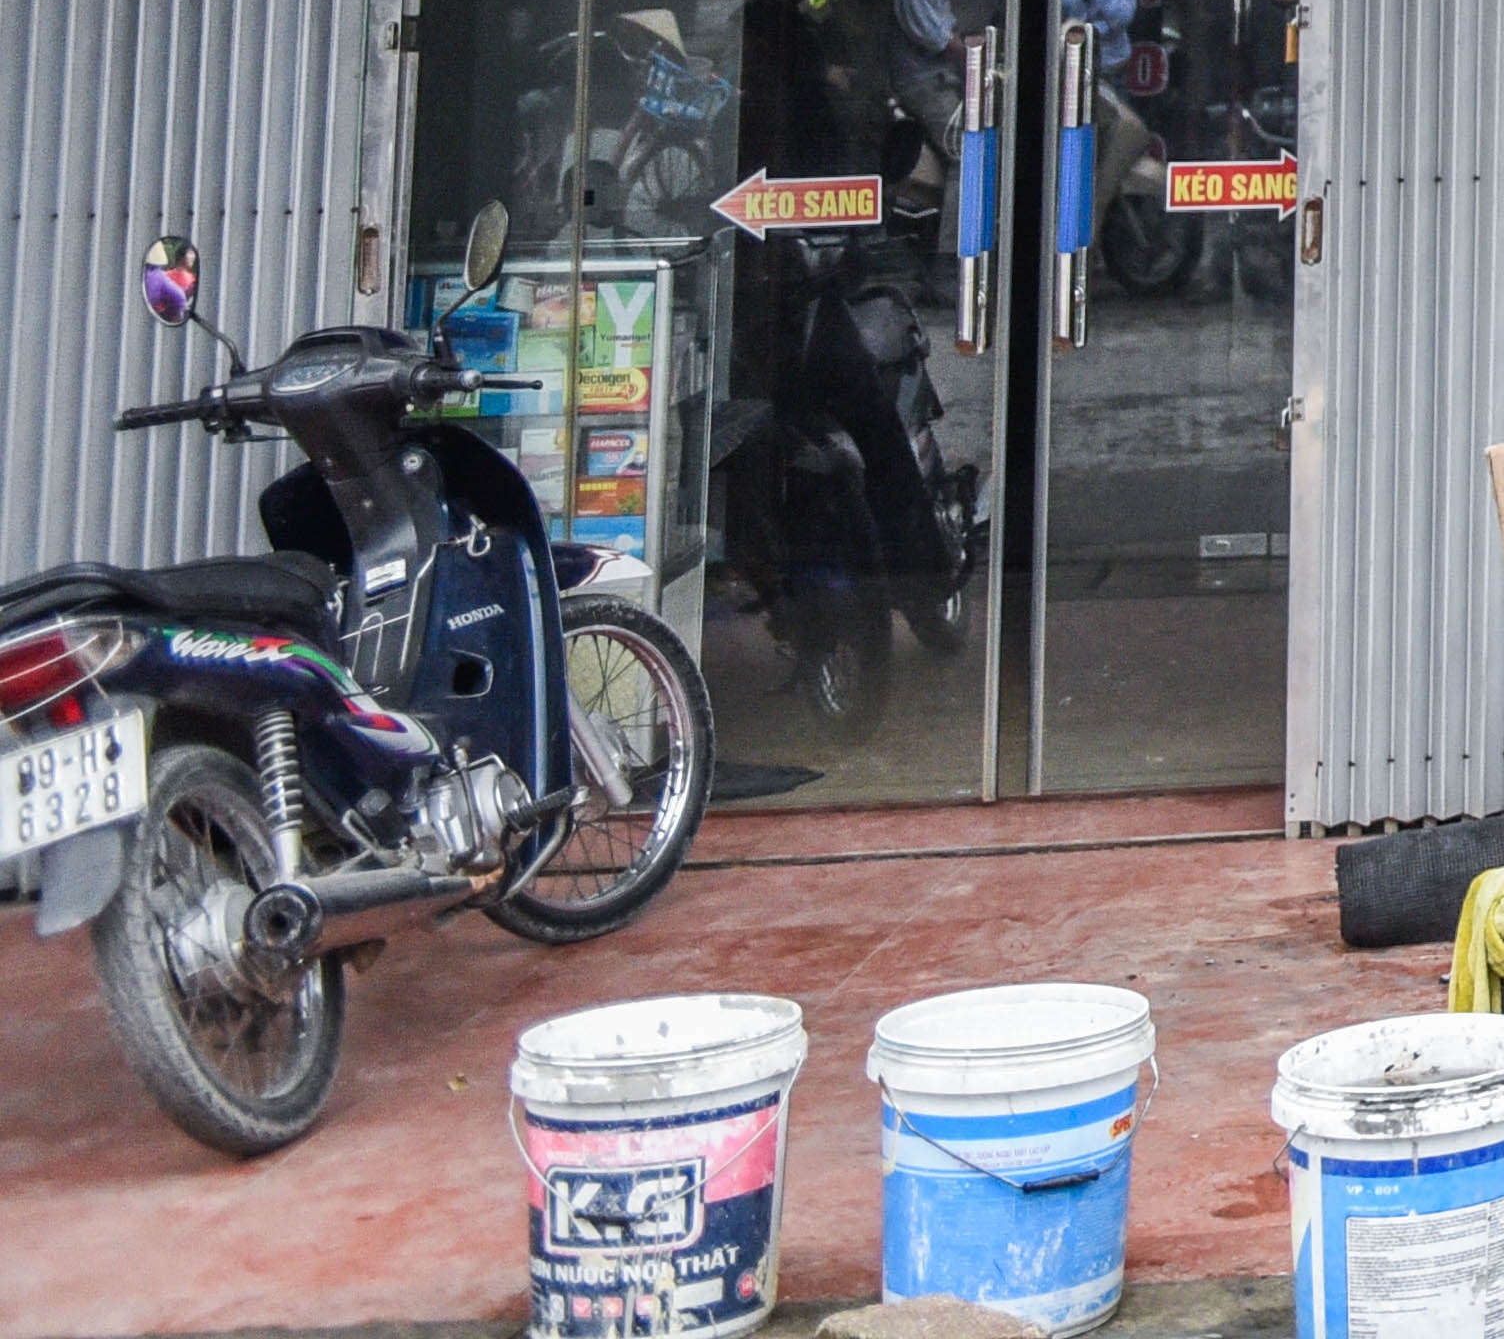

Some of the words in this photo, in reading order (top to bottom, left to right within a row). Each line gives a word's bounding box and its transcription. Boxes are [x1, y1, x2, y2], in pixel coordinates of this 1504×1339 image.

[744, 180, 796, 220] KÉO
[803, 187, 875, 219] SANG
[1173, 169, 1223, 203] KÉO
[1230, 173, 1298, 201] SANG
[447, 604, 505, 630] HONDA
[172, 629, 251, 659] Wave
[18, 771, 119, 843] 6328
